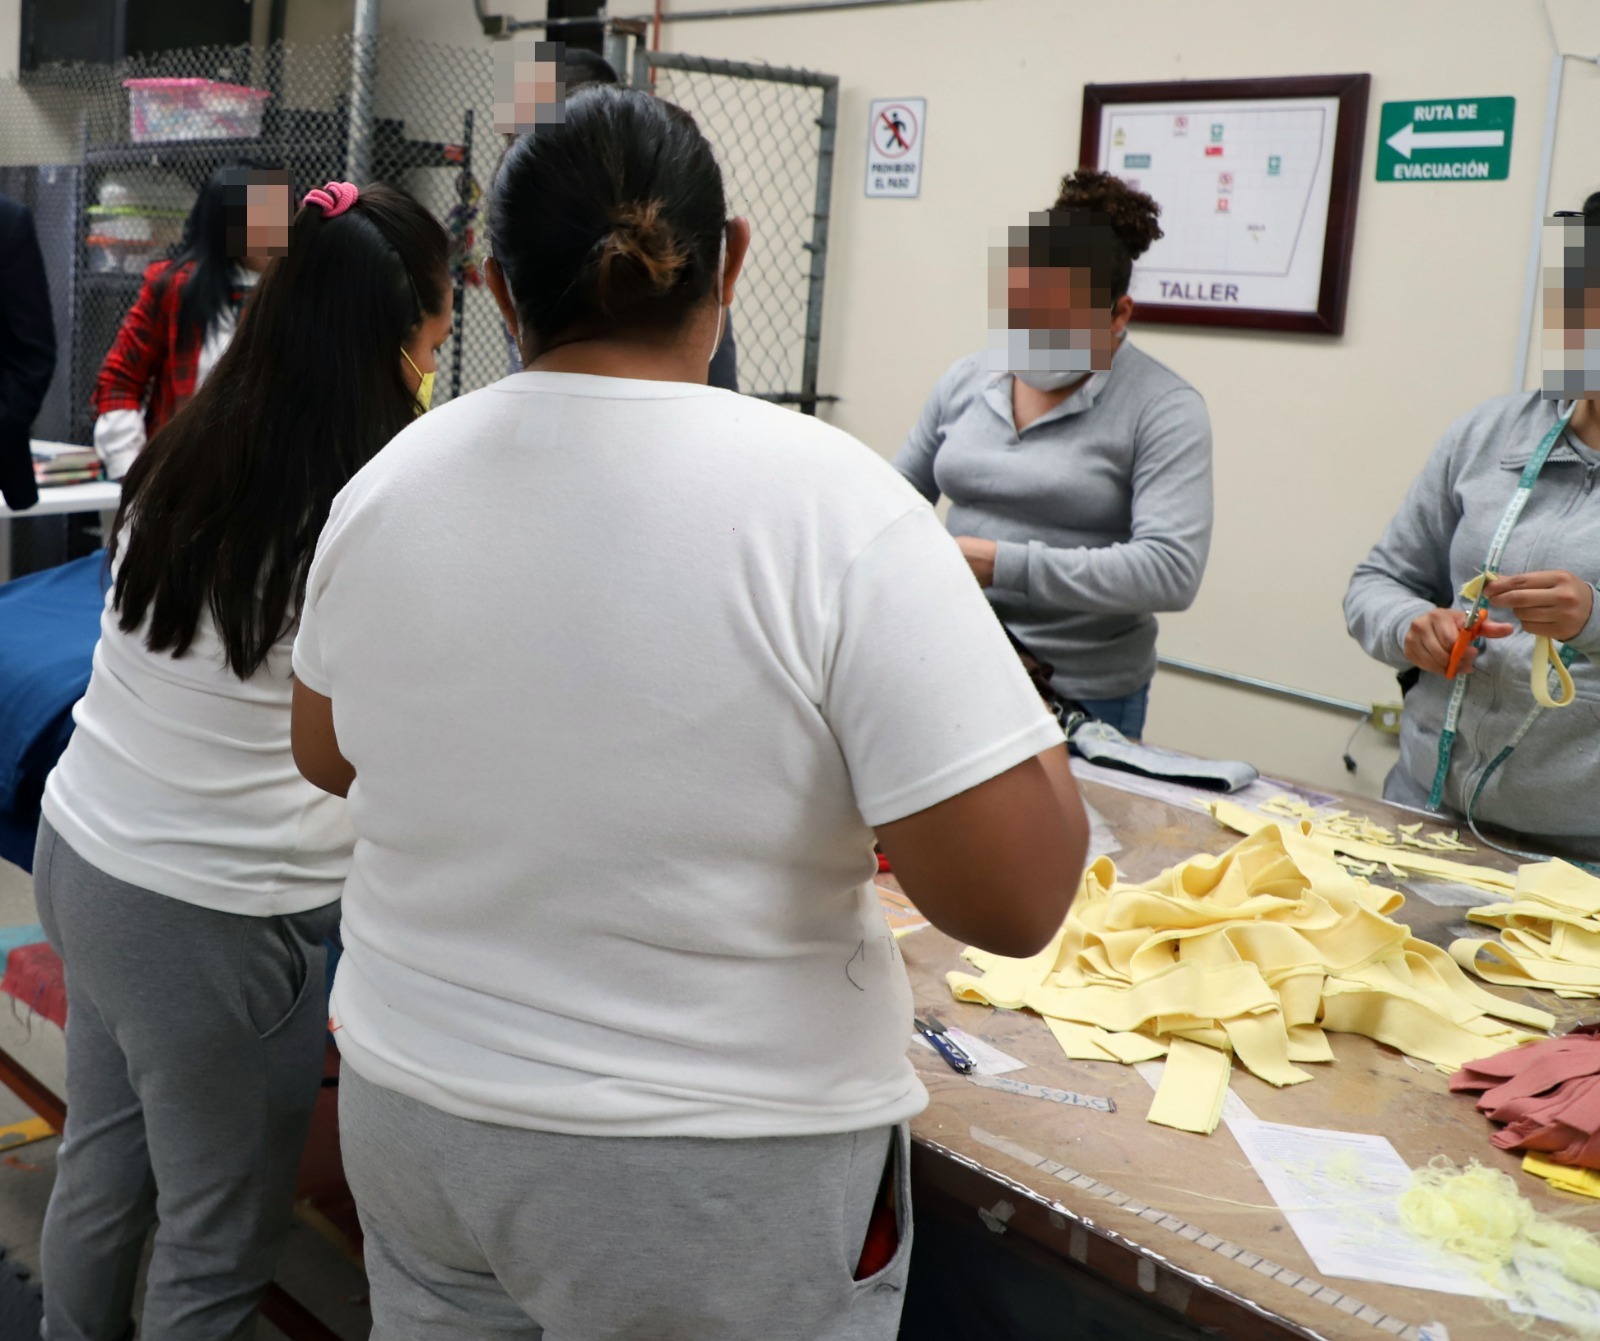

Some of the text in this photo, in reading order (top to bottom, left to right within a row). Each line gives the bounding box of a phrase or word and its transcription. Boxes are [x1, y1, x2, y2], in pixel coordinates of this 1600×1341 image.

[1413, 103, 1478, 121] RUTA DE
[871, 162, 916, 173] PROHIBIDO
[1393, 160, 1489, 179] EVACUACIÓN
[875, 177, 909, 188] EL PASO
[1159, 281, 1239, 303] TALLER
